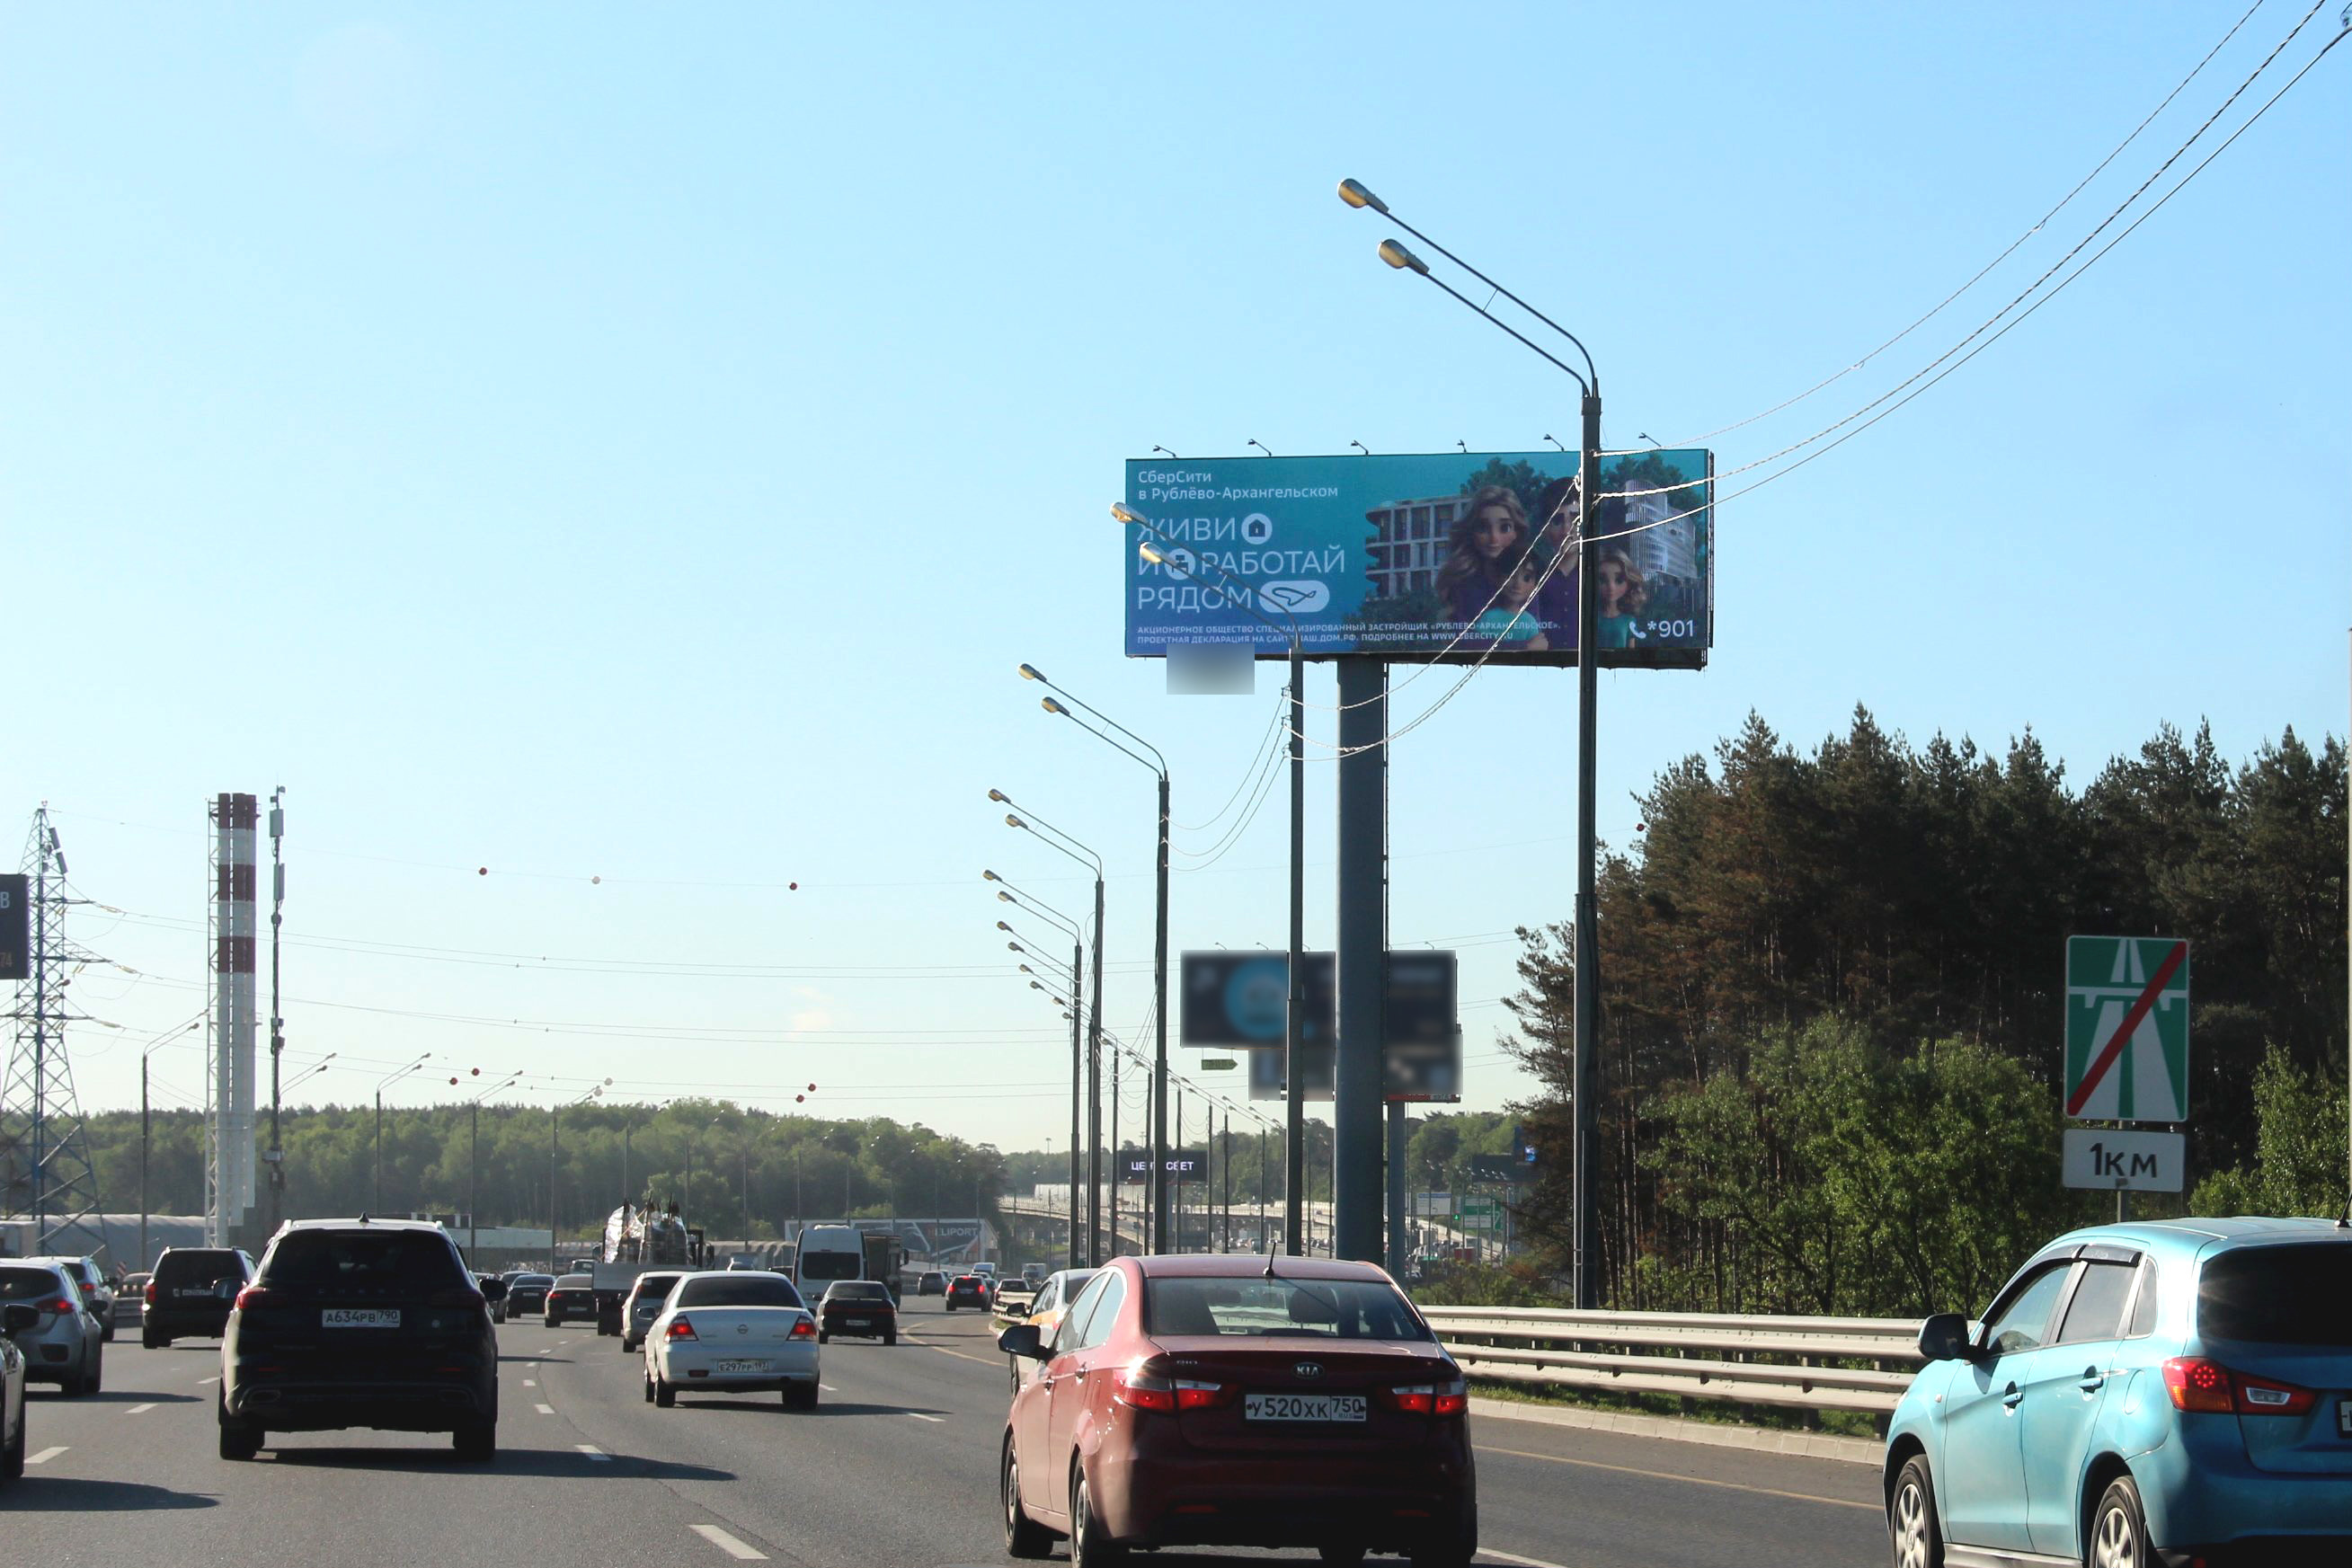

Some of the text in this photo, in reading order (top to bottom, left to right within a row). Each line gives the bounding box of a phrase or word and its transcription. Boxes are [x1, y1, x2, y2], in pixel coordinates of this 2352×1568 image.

[1138, 470, 1212, 485] СберСити
[1139, 486, 1338, 503] в Рублёво-Архангельском
[1137, 517, 1236, 541] ЖИВИ
[1201, 544, 1345, 575] РАБОТАЙ
[1138, 586, 1252, 614] РЯДОМ
[1137, 625, 1203, 634] АКЦИОНЕРНОЕ
[1205, 625, 1254, 633] ОБЩЕСТВО
[1368, 621, 1428, 632] ЗАСТРОЙЩИК
[1431, 621, 1561, 631] «РУБЛЕВО-АРХАНЕЛЬСКОЕ».
[1137, 635, 1190, 644] ПРОЕКТНАЯ
[1191, 635, 1250, 644] ДЕКЛАРАЦИЯ
[1252, 634, 1265, 642] НА
[1266, 633, 1295, 642] САЙТ
[1362, 633, 1415, 642] ПОДРОБНЕЕ
[1416, 633, 1429, 641] НА
[1297, 1366, 1318, 1376] KIA
[1332, 1398, 1362, 1413] 750
